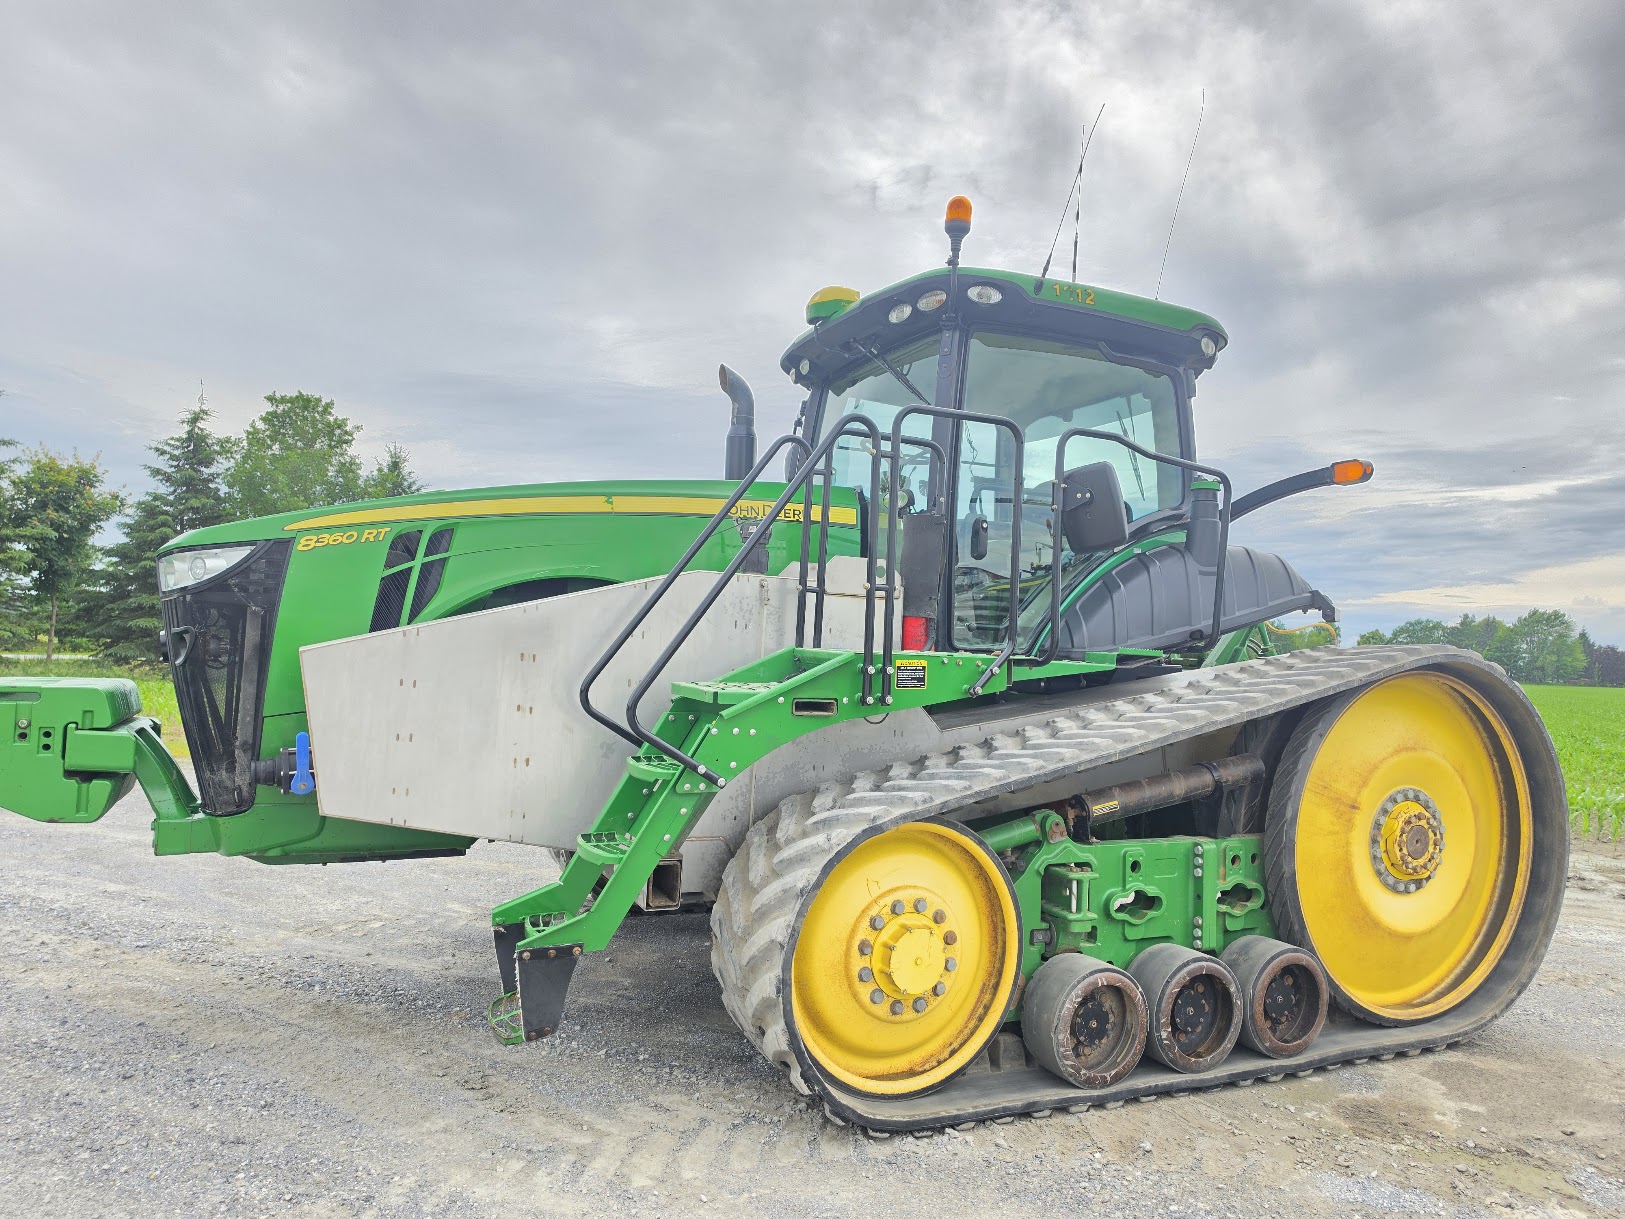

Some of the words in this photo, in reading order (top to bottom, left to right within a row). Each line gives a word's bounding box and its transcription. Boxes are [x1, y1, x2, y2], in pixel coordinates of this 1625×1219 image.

[1052, 283, 1095, 305] 112
[725, 504, 760, 517] OHN
[762, 504, 806, 519] DER
[296, 531, 358, 551] 8360
[360, 527, 392, 543] RT
